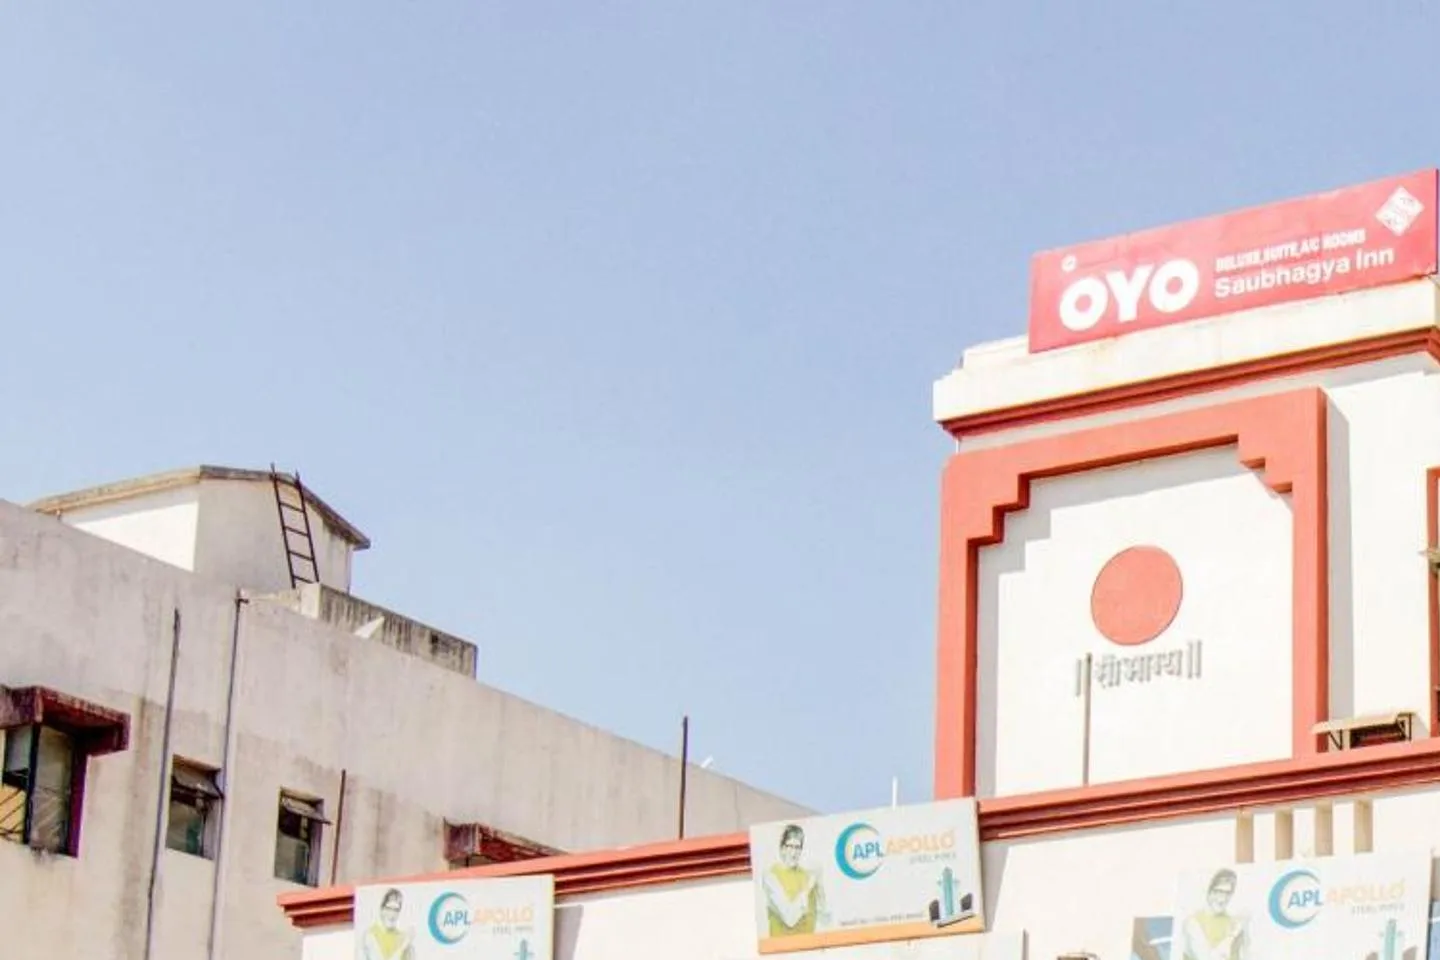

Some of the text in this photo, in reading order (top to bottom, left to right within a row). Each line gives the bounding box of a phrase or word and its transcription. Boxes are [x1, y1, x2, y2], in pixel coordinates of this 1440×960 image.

[1215, 248, 1394, 298] Saubhagya Inn
[1059, 259, 1199, 331] OYO
[853, 832, 955, 861] APL APOLLO
[1287, 890, 1323, 909] APL
[443, 909, 471, 927] APL
